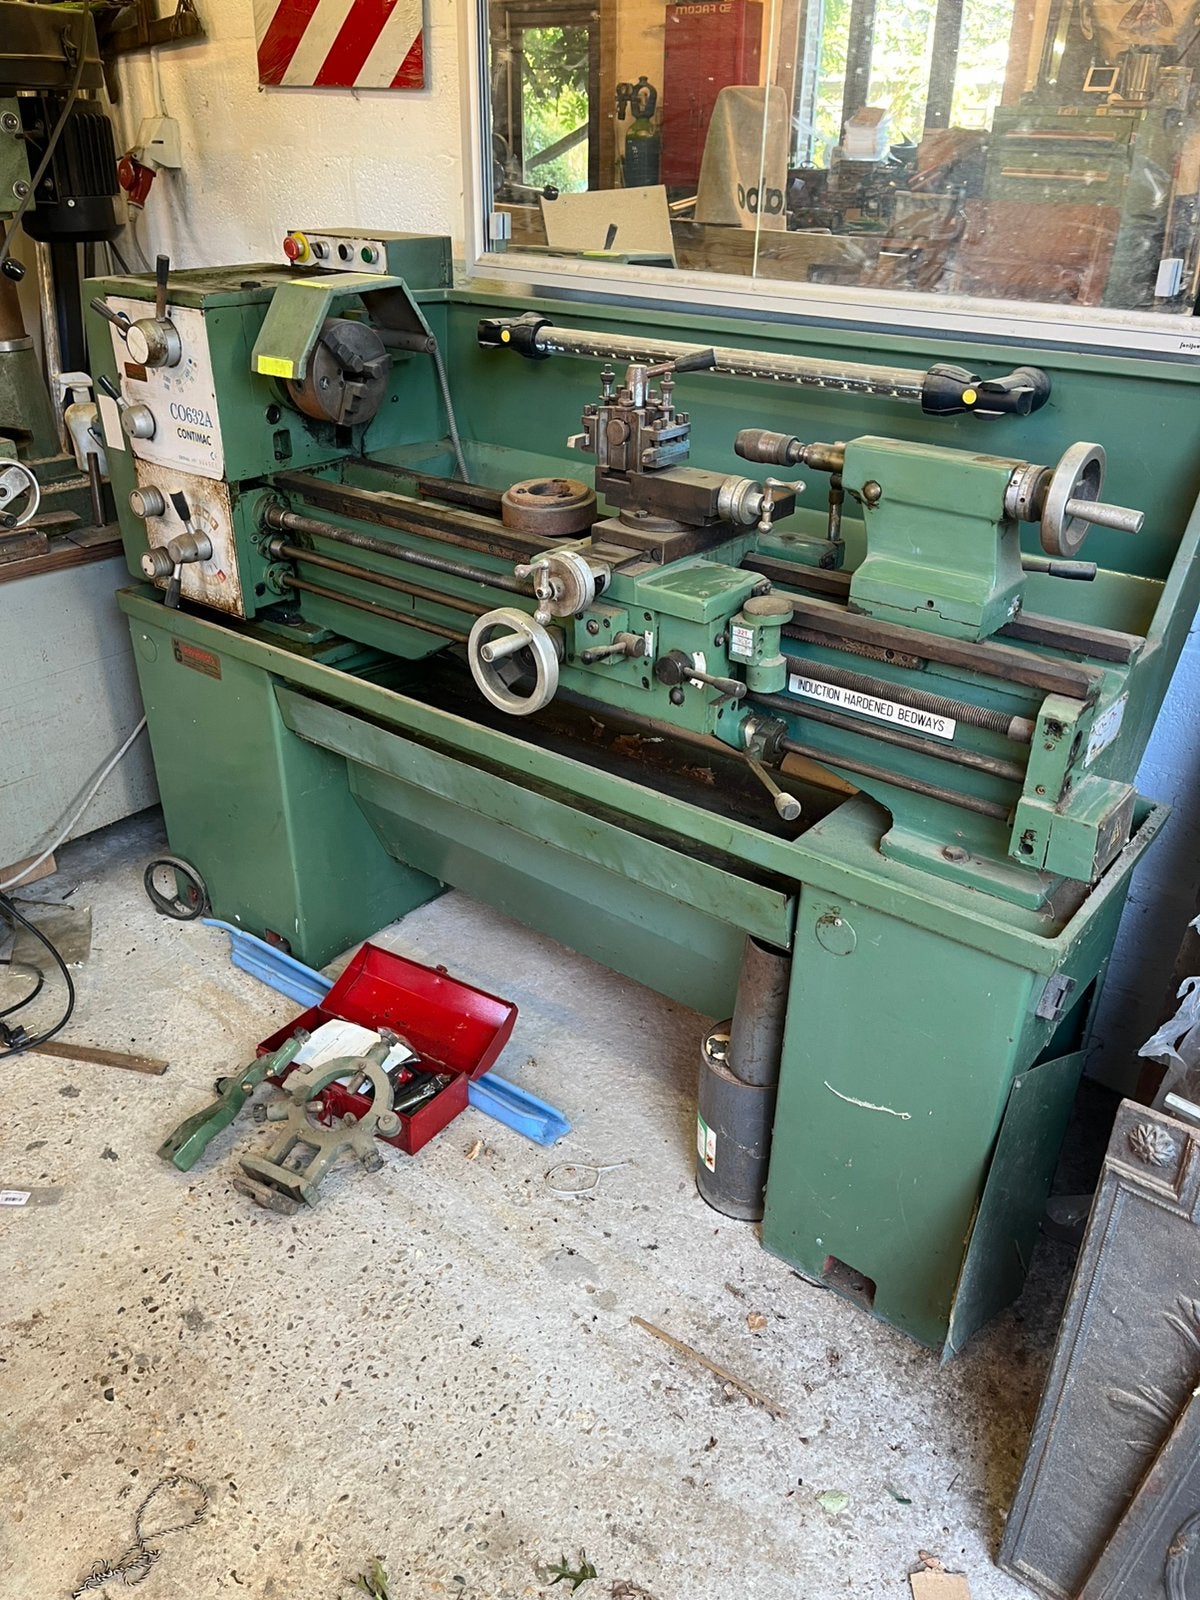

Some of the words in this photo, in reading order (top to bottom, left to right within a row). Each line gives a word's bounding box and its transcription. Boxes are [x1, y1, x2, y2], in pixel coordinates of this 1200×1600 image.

[170, 402, 213, 428] CO632A
[177, 427, 212, 446] CONTIMAC
[797, 678, 841, 701] INDUCTION
[843, 693, 894, 717] HARDENED
[897, 708, 945, 732] BEDWAYS
